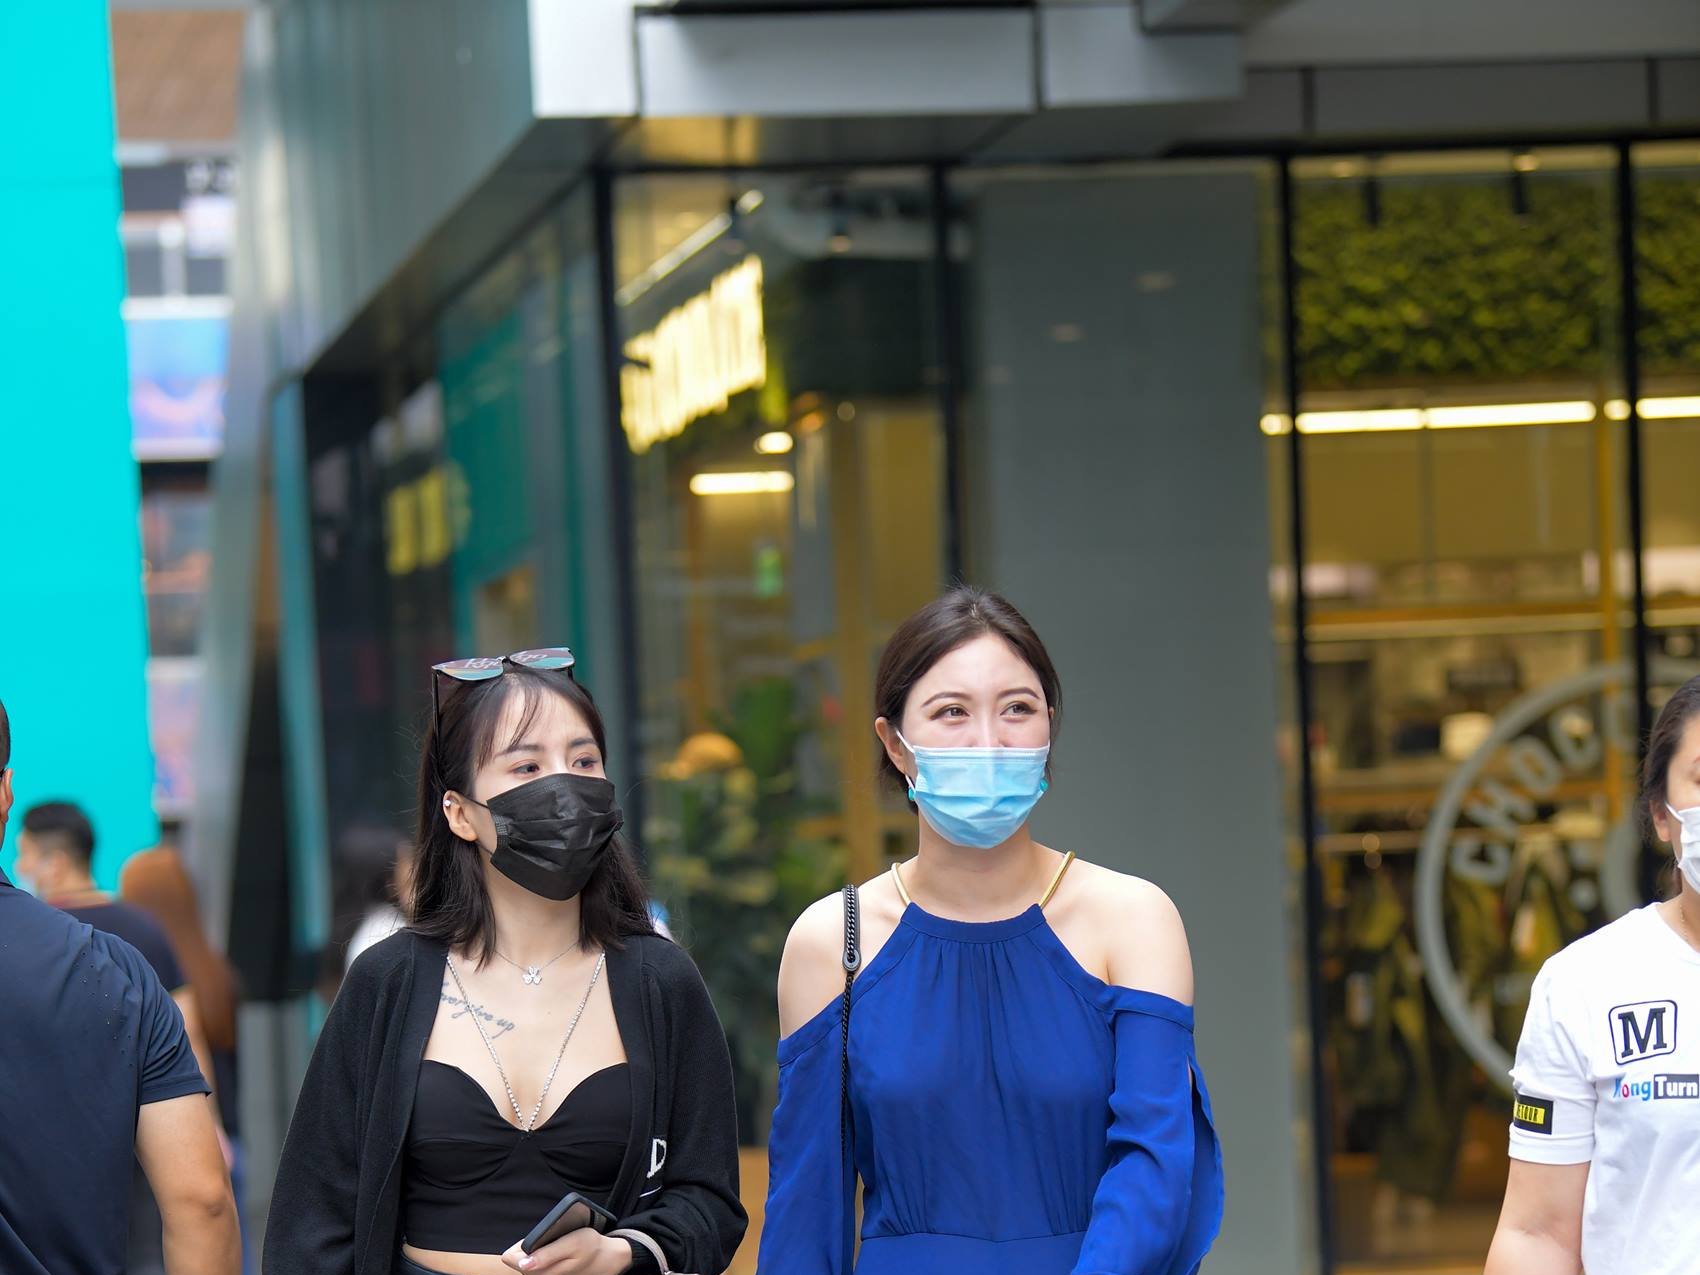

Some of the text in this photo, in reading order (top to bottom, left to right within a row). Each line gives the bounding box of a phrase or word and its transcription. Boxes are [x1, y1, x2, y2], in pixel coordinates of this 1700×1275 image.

[1617, 1007, 1667, 1058] M
[1655, 1076, 1698, 1097] Turn
[1515, 1104, 1540, 1122] ETOUR
